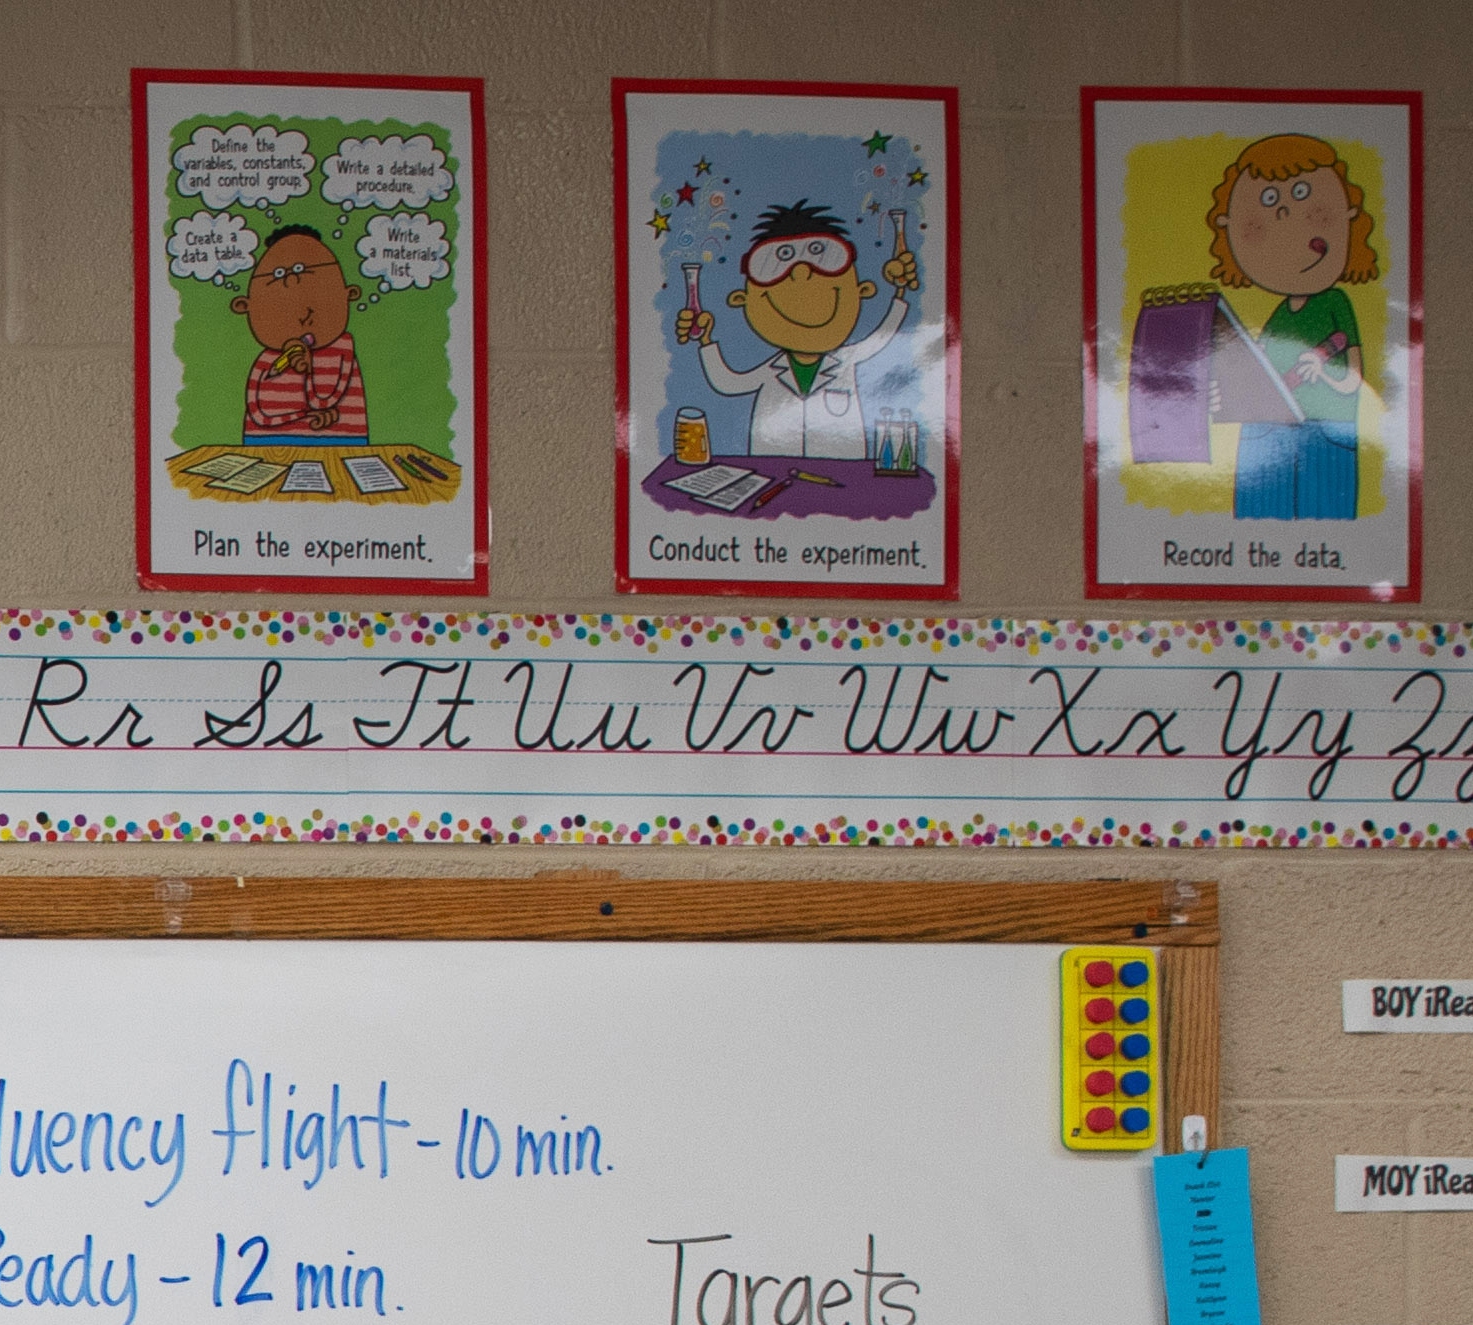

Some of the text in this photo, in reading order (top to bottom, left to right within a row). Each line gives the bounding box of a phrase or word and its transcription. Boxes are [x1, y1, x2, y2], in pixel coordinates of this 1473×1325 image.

[212, 139, 275, 154] Define the
[184, 156, 237, 171] variables,
[337, 161, 434, 176] Write a detailed
[189, 173, 210, 187] and
[218, 173, 260, 187] control
[186, 231, 237, 245] Create a
[388, 229, 419, 243] Write
[182, 249, 208, 262] data
[370, 246, 437, 261] a materials
[195, 530, 432, 566] Plan the experiment.
[649, 535, 926, 574] Conduct the experiment.
[1164, 541, 1345, 571] Record the data.
[1372, 986, 1423, 1017] BOY
[517, 1118, 614, 1181] min.
[1363, 1164, 1420, 1197] MOY
[212, 1232, 271, 1310] 12
[296, 1249, 403, 1315] min.
